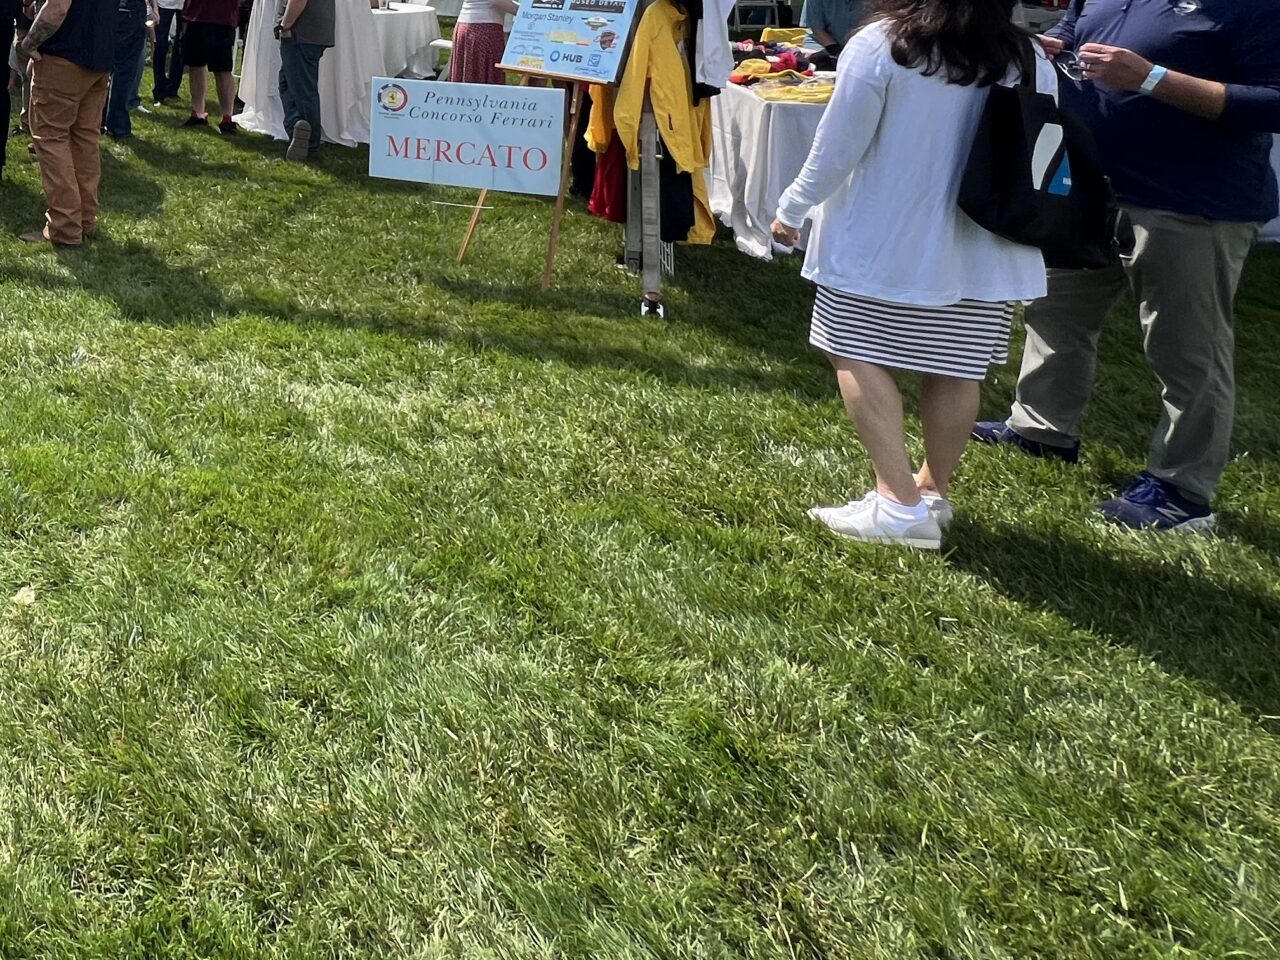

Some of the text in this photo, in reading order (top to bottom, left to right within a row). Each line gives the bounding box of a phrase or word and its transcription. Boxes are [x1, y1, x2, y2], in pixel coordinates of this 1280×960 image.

[598, 0, 626, 7] DETAIL
[521, 10, 575, 24] Morgan Stanley
[561, 53, 583, 63] HUB
[423, 91, 538, 112] Pennsylvania
[409, 106, 483, 124] Concorso
[490, 112, 554, 128] Ferrari
[385, 134, 548, 172] MERCATO
